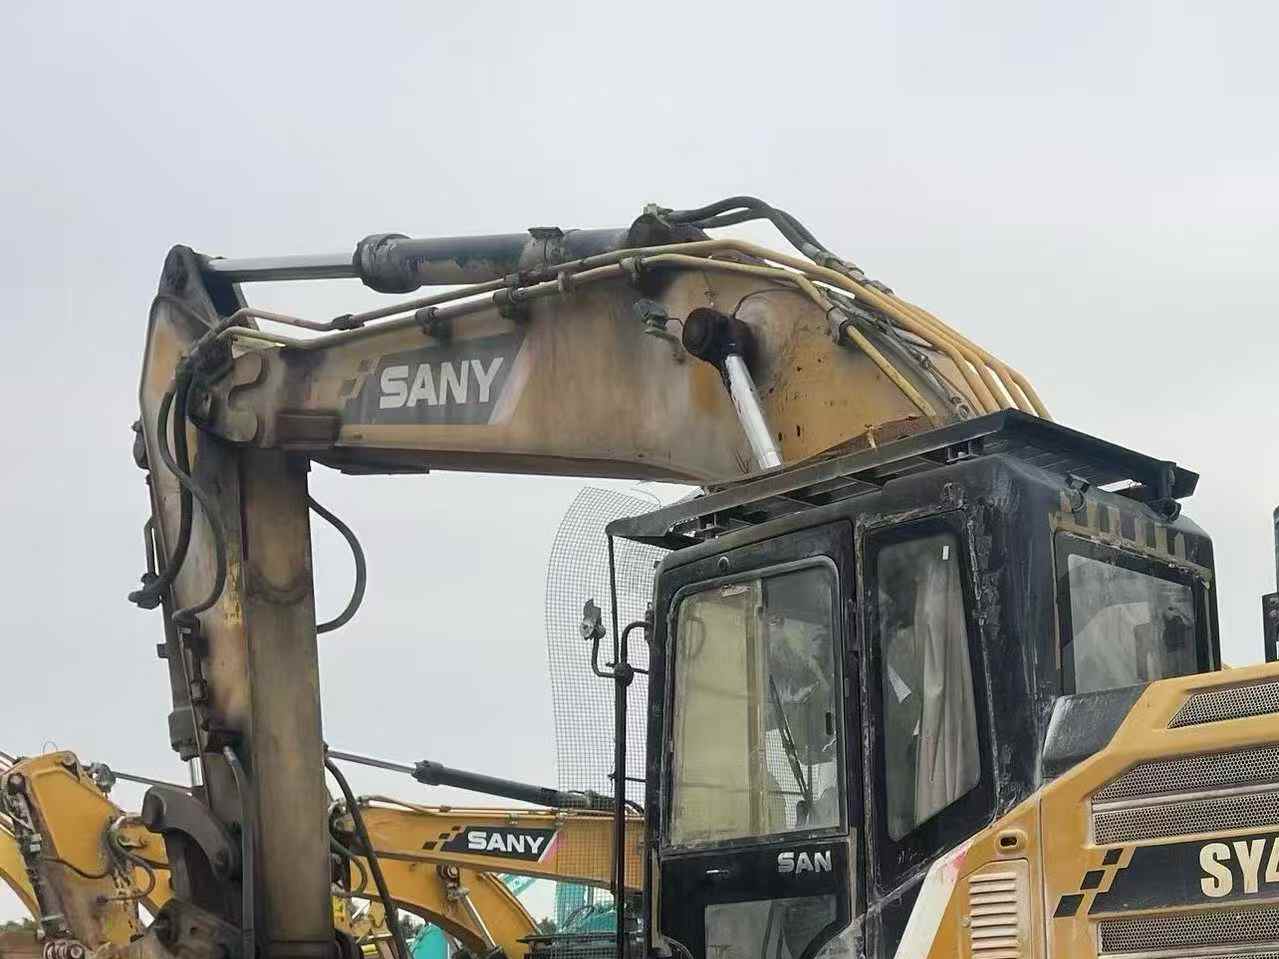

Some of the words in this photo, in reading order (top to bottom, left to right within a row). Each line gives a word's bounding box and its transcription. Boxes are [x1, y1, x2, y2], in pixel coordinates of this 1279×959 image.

[379, 357, 504, 409] SANY
[467, 830, 545, 854] SANY
[777, 850, 832, 874] SAN
